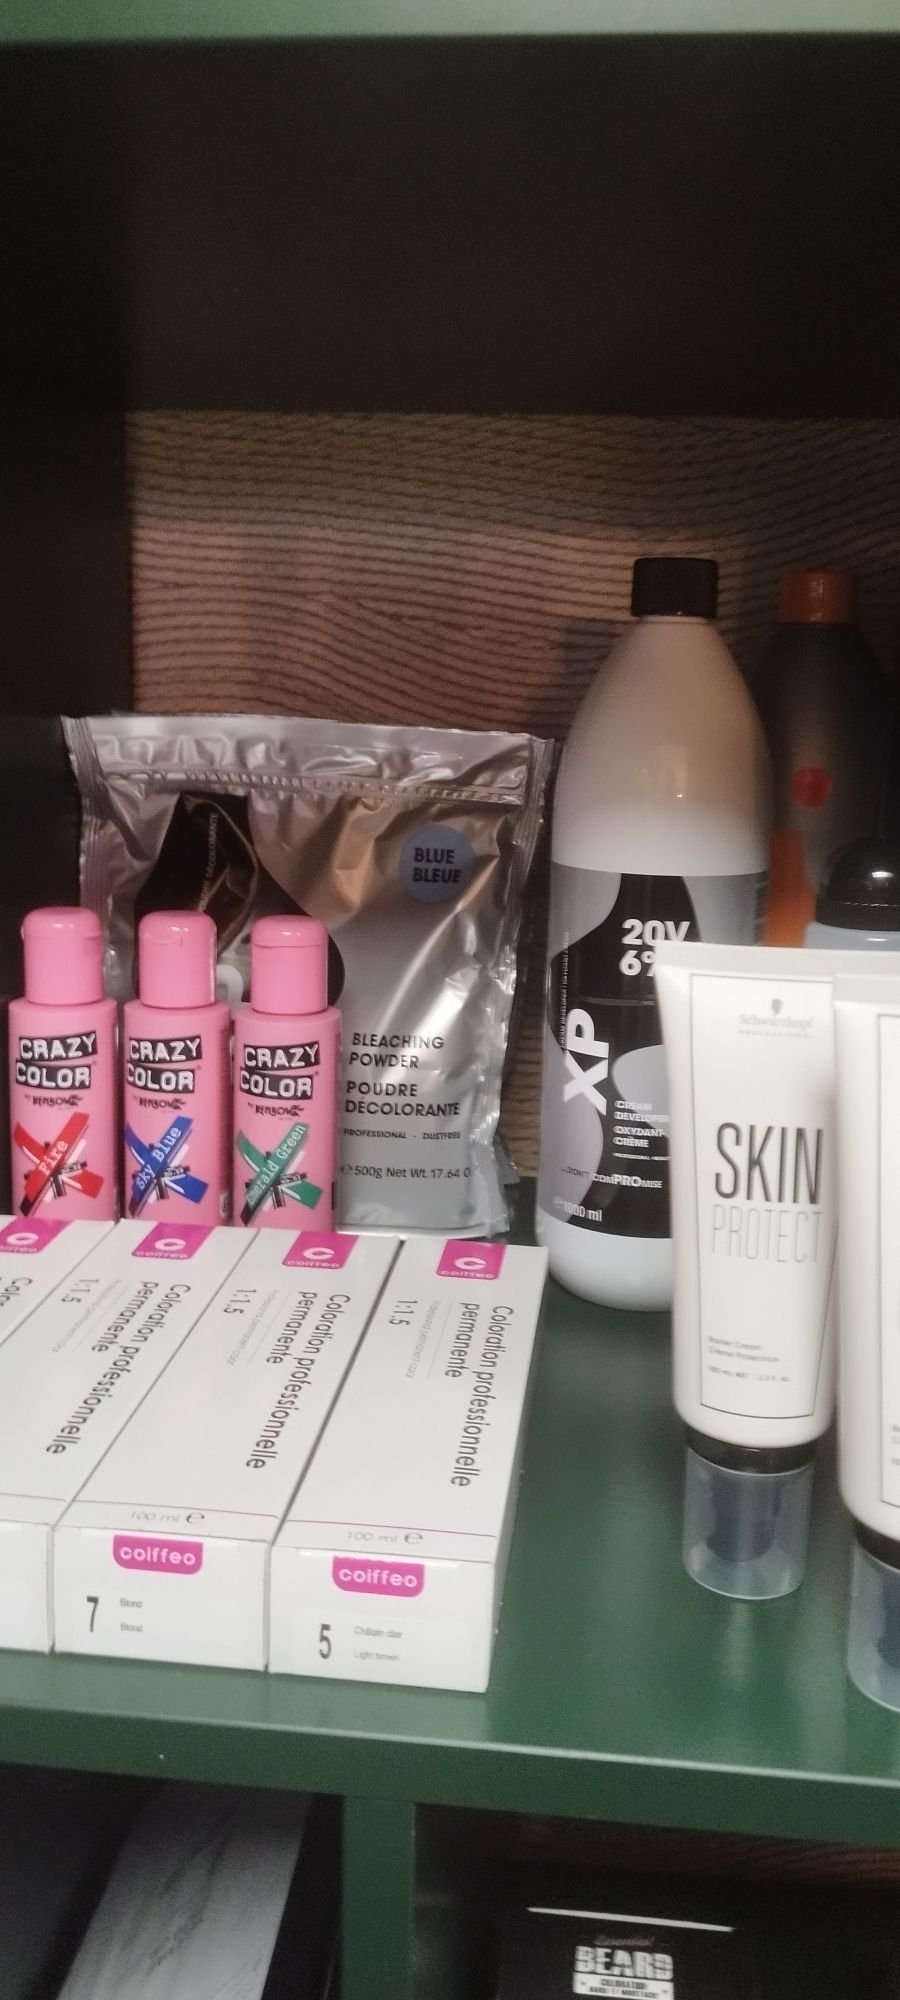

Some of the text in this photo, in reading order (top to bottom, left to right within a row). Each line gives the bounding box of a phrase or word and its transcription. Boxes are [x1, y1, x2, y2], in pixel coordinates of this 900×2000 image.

[414, 848, 455, 864] BLUE
[412, 867, 462, 883] BLEUE
[621, 918, 690, 946] 20V
[19, 1032, 96, 1061] CRAZY
[129, 1037, 201, 1062] CRAZY
[352, 1032, 444, 1049] BLEACHING
[243, 1043, 319, 1069] CRAZY
[349, 1051, 419, 1068] POWDER
[564, 1008, 609, 1116] XP
[16, 1061, 91, 1088] COLOR
[126, 1062, 194, 1091] COLOR
[239, 1069, 312, 1097] COLOR
[346, 1080, 418, 1097] POUDRE
[345, 1097, 460, 1117] DÉCOLORANTE
[152, 1126, 182, 1163] Blue
[276, 1124, 306, 1159] Green
[344, 1128, 407, 1139] PROFESSIONAL
[39, 1140, 68, 1176] Fire
[354, 1165, 382, 1178] 500g
[387, 1167, 406, 1178] Net
[431, 1168, 459, 1179] 17.64
[715, 1121, 824, 1205] SKIN
[564, 1201, 586, 1217] 1000
[586, 1209, 602, 1222] ml
[711, 1203, 824, 1263] PROTECT
[91, 1280, 159, 1352] permanente
[130, 1283, 192, 1343] Coloration
[304, 1294, 352, 1354] Coloration
[388, 1299, 418, 1326] 1:1.5
[266, 1291, 318, 1365] permanente
[444, 1302, 480, 1379] permanente
[46, 1345, 140, 1455] professionnelle
[450, 1305, 515, 1488] Coloration professionnelle
[246, 1356, 316, 1469] professionnelle
[130, 1511, 157, 1522] 100
[160, 1512, 180, 1524] ml
[347, 1531, 374, 1542] 100
[378, 1533, 398, 1544] ml
[119, 1546, 197, 1566] coiffeo
[338, 1568, 418, 1588] coiffeo
[86, 1595, 99, 1633] 7
[119, 1597, 143, 1609] Blond
[120, 1622, 144, 1634] Blond
[319, 1623, 332, 1660] 5
[575, 1946, 673, 1979] BEARD
